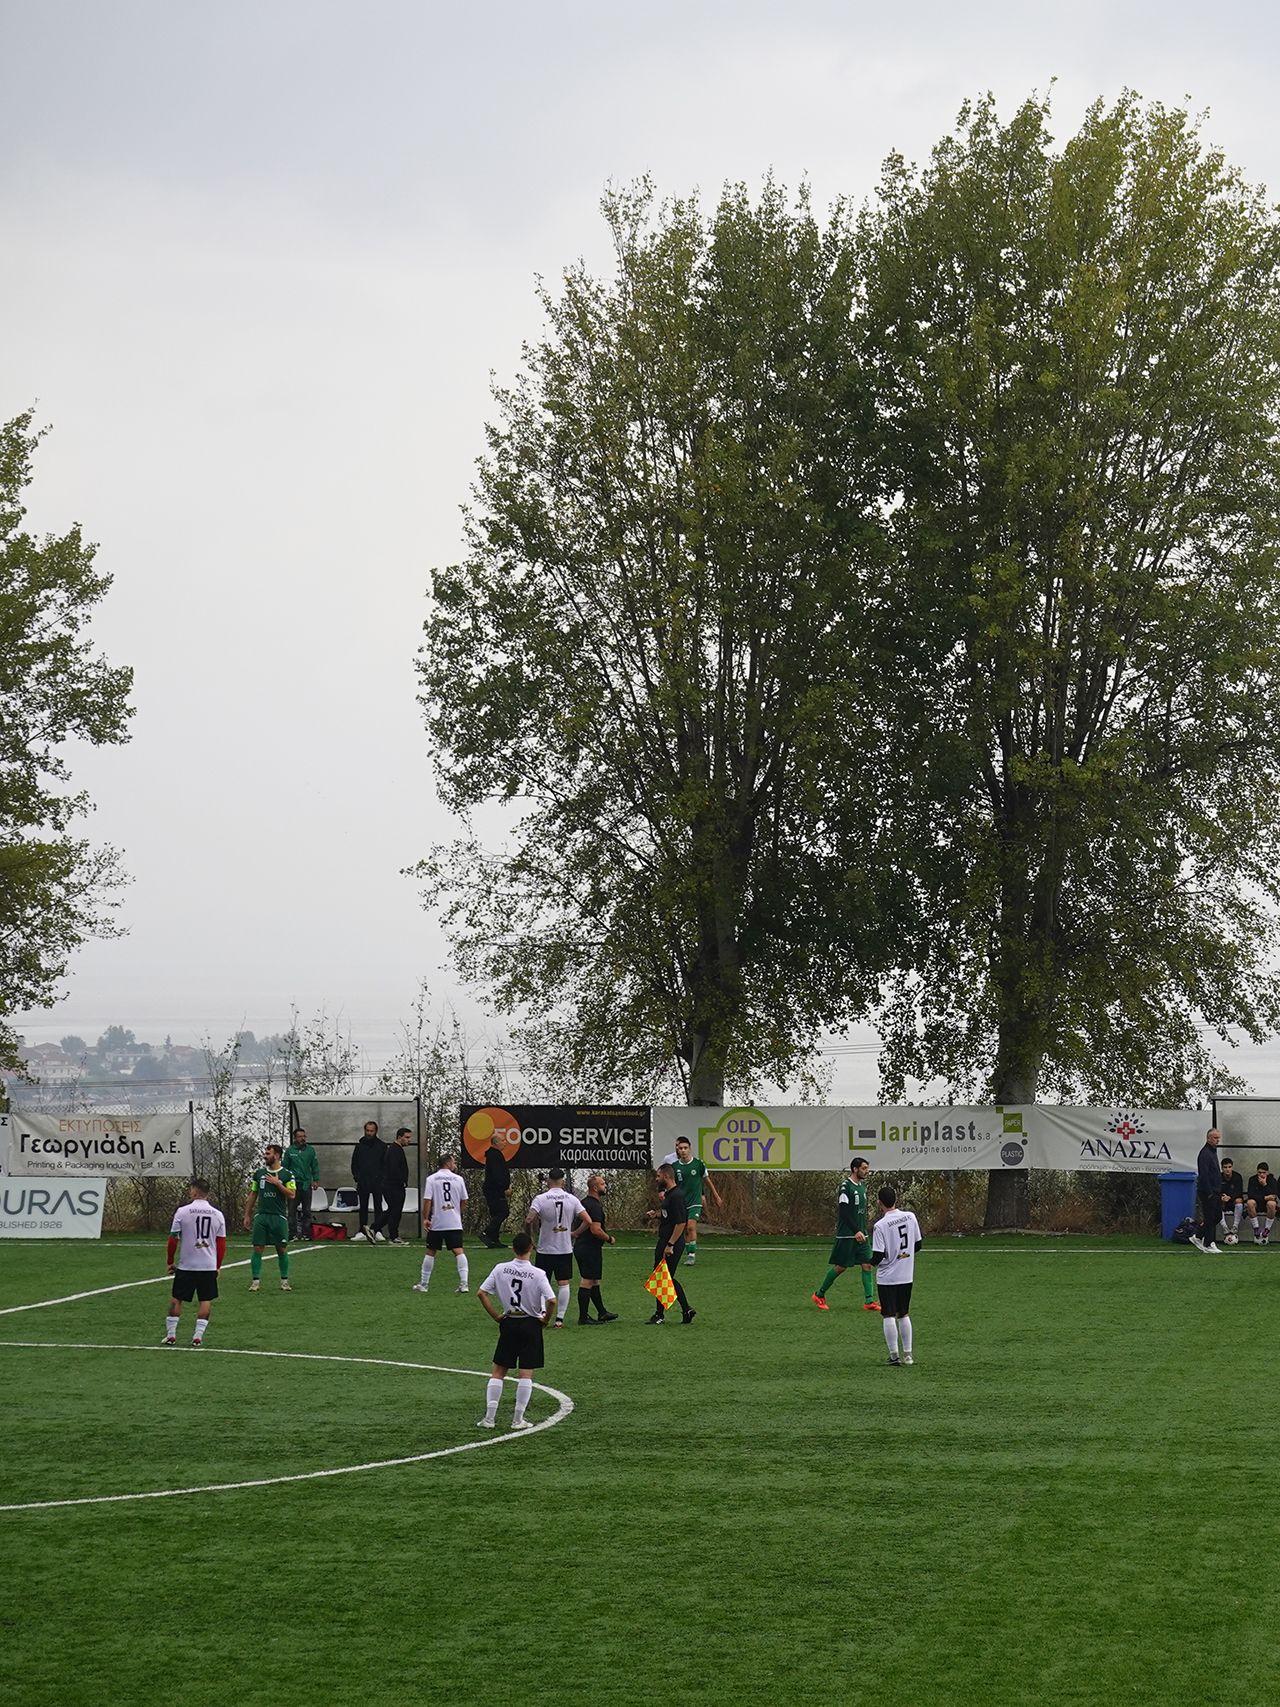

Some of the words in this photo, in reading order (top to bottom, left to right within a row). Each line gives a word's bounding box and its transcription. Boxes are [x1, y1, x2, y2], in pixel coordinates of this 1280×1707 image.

[59, 1119, 142, 1133] ΕΚΤΥΠΩΣΕΙΣ
[727, 1119, 762, 1134] OLD
[881, 1121, 976, 1146] lariplast
[21, 1133, 144, 1160] Γεωργιάδη
[559, 1128, 648, 1146] SERVICE
[560, 1147, 648, 1165] καρακατσάνης
[942, 1145, 977, 1153] solutions
[28, 1160, 55, 1171] Printing
[65, 1161, 104, 1171] Packaging
[106, 1161, 135, 1171] Industry
[157, 1161, 175, 1169] 1923
[443, 1181, 451, 1202] 8
[0, 1190, 99, 1216] URAS
[555, 1201, 563, 1223] 7
[40, 1221, 63, 1229] 1926
[195, 1215, 211, 1239] 10
[898, 1224, 908, 1250] 5
[511, 1278, 523, 1307] 3
